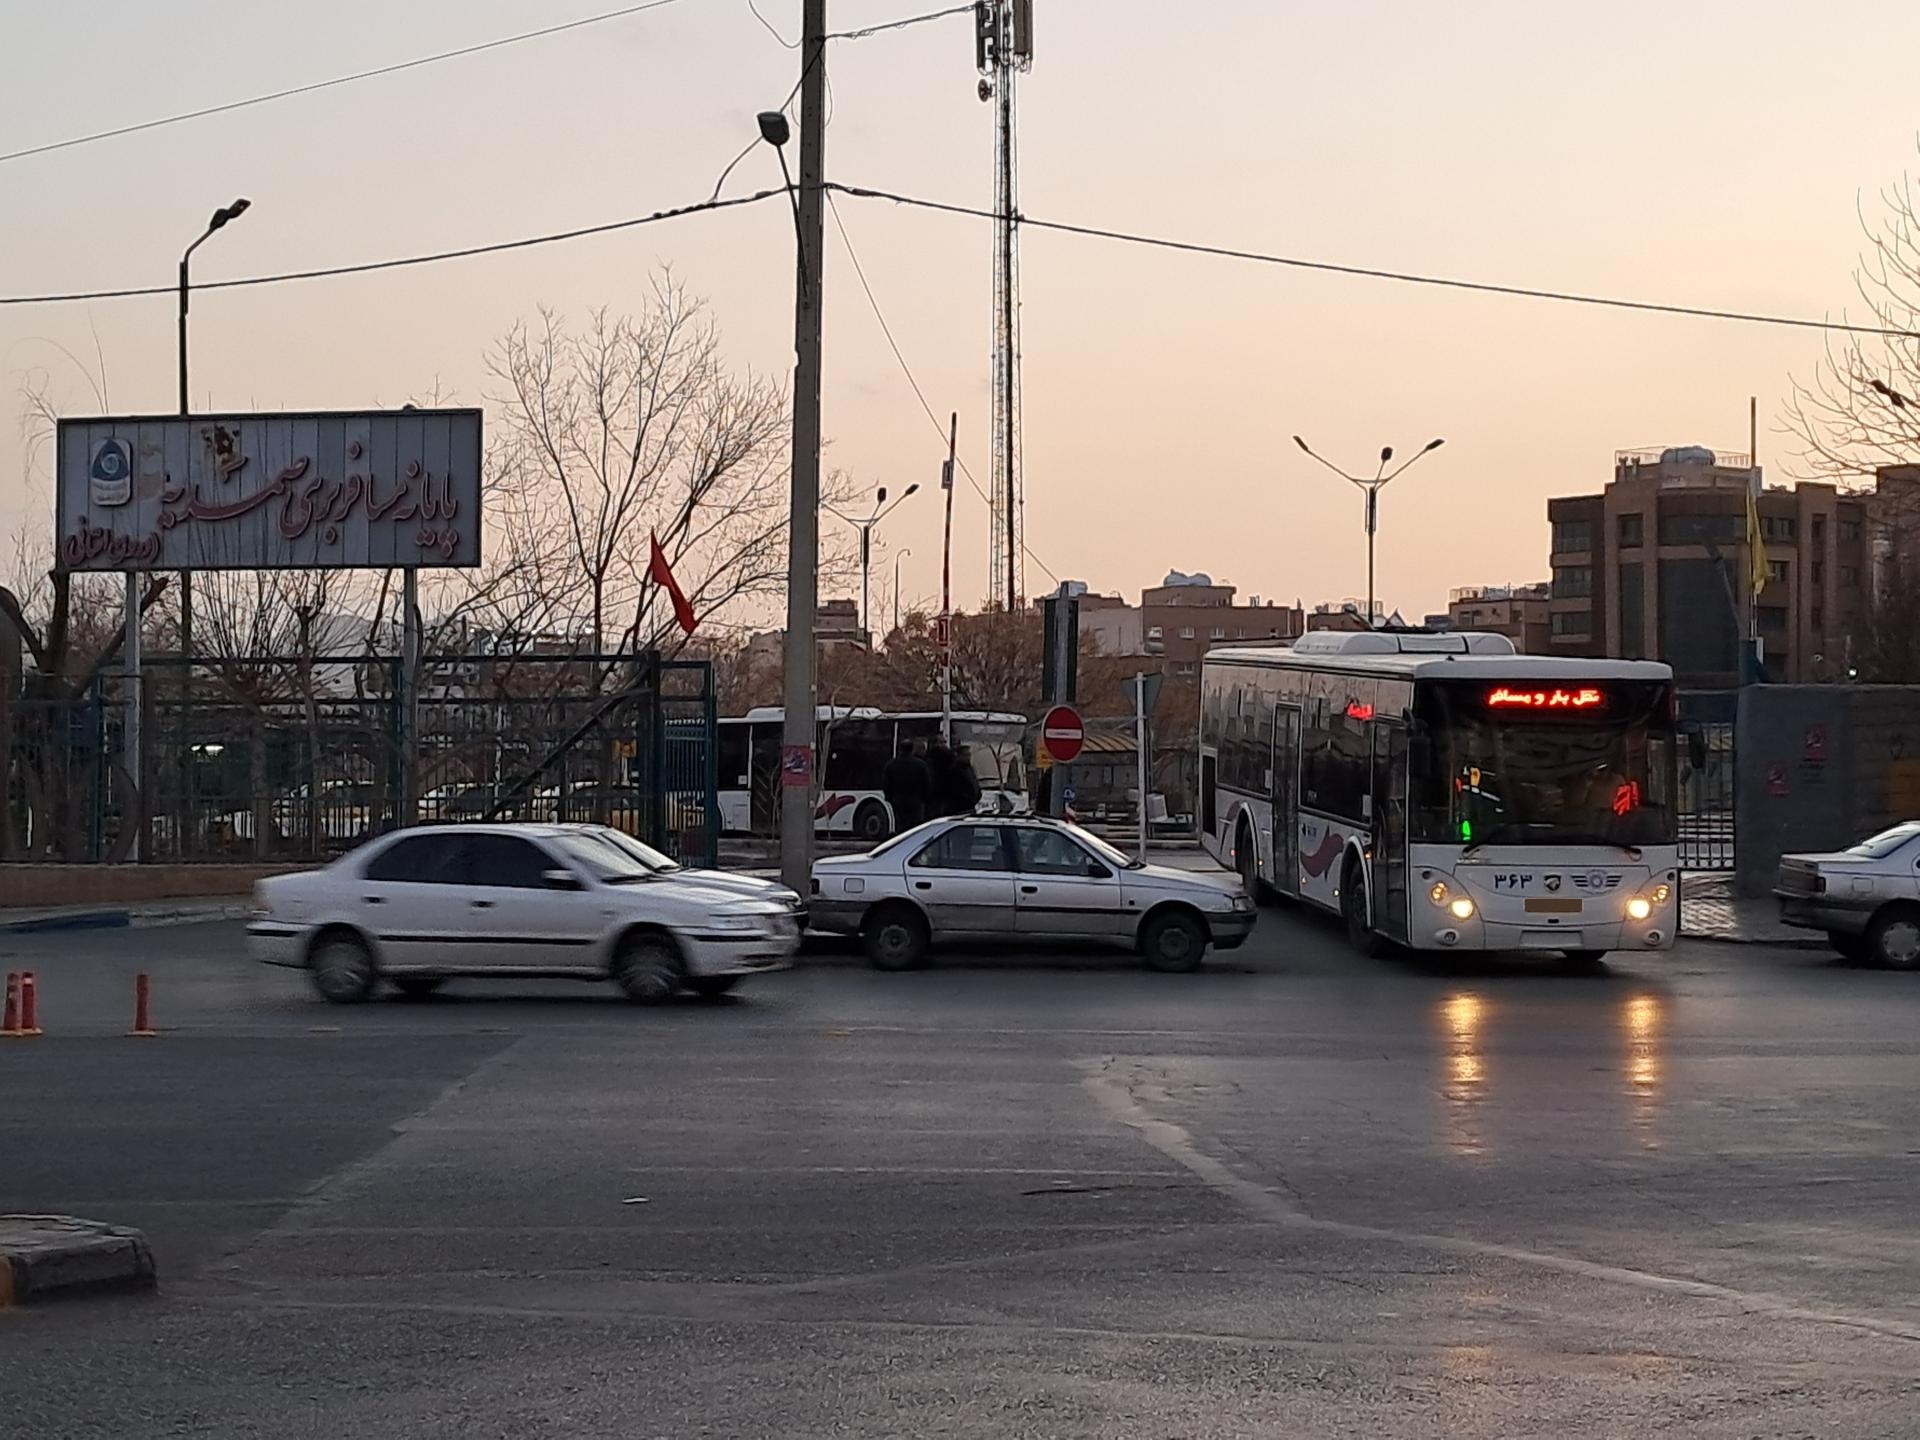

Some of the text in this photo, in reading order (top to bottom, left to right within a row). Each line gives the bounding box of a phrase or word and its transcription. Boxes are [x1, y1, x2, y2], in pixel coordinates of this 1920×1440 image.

[278, 441, 409, 539] مسافربری
[391, 460, 460, 560] پایانه
[1488, 688, 1532, 706] مسافر
[1533, 692, 1546, 706] و
[1549, 689, 1570, 706] بار
[1493, 873, 1534, 890] ۳۶۳
